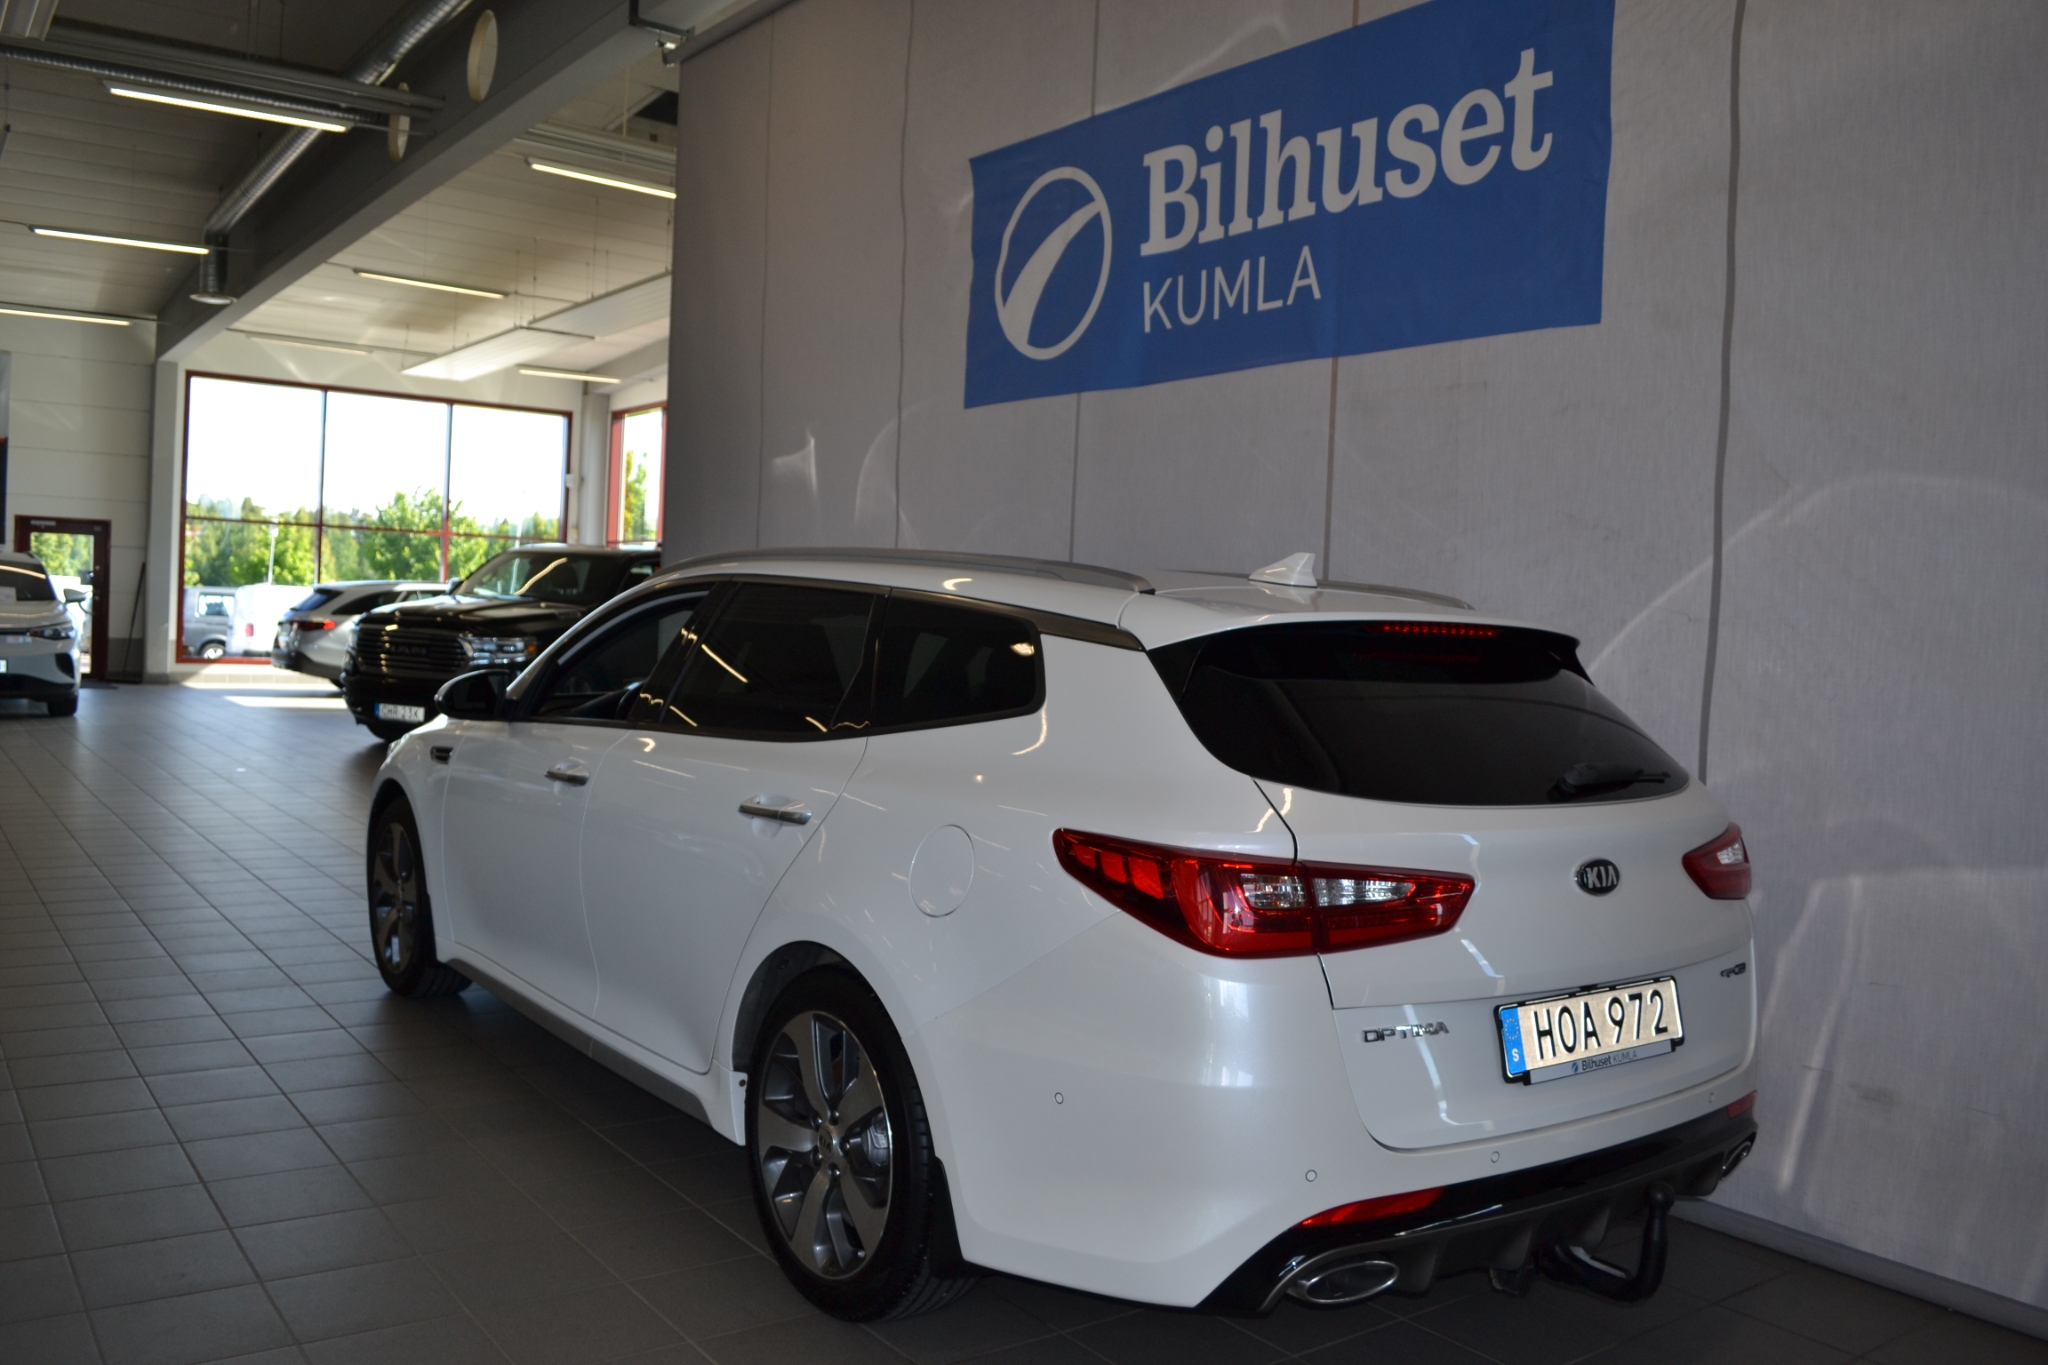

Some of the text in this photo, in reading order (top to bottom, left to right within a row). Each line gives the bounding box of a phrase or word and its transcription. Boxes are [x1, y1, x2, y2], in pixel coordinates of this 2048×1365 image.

[1140, 47, 1553, 257] Bilhuset
[1142, 245, 1322, 333] KUMLA
[1585, 865, 1617, 889] KIA
[1362, 1021, 1450, 1043] OPTIMA
[1532, 989, 1669, 1060] HOA 972
[1511, 1049, 1520, 1062] S
[1581, 1050, 1638, 1071] Bilhuset KUMLA
